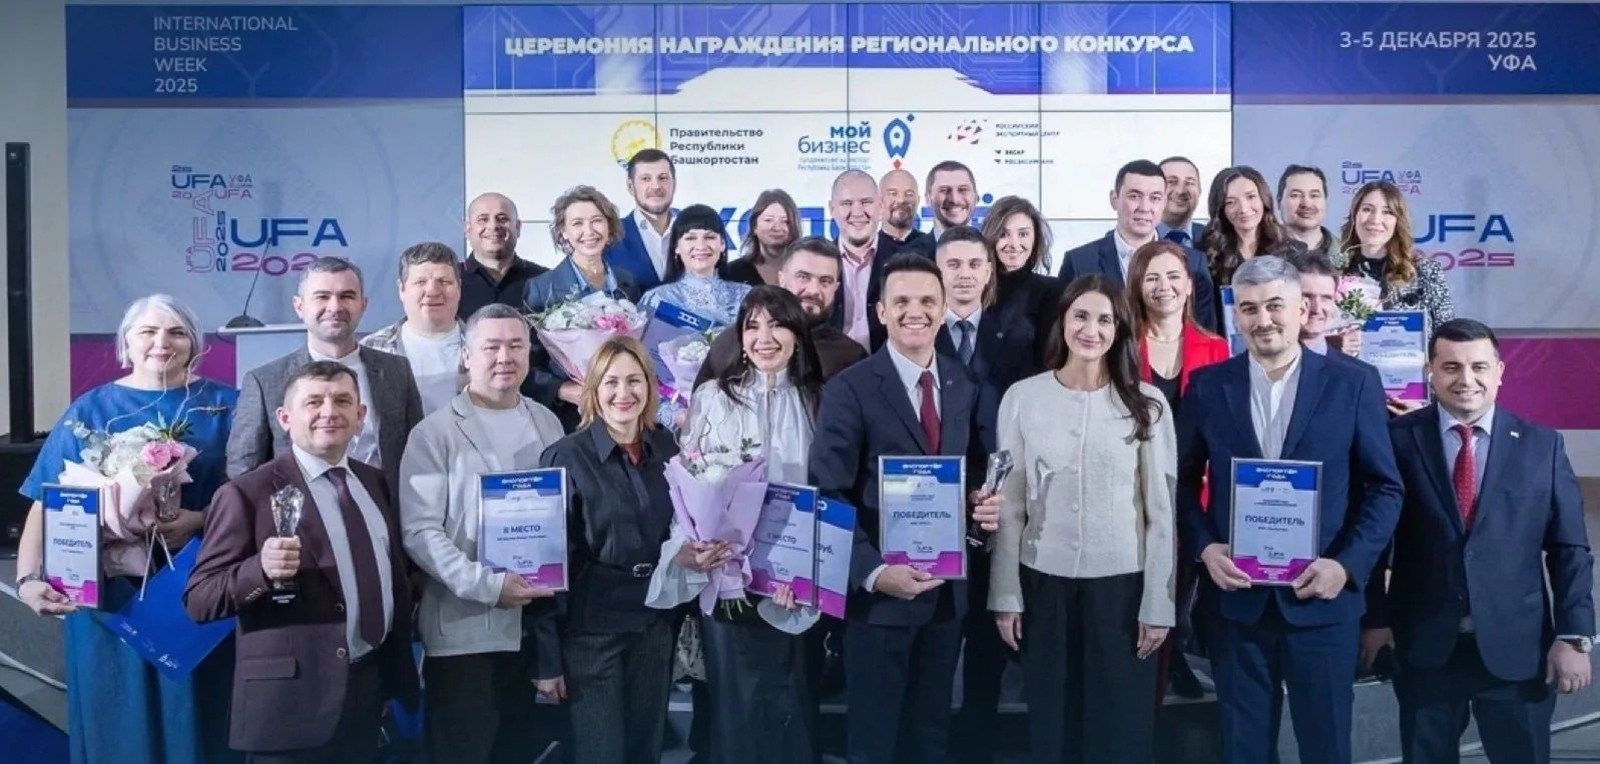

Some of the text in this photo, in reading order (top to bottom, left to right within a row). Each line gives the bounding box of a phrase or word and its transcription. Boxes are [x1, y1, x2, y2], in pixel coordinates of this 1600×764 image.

[153, 15, 299, 31] INTERNATIONAL
[153, 36, 242, 51] BUSINESS
[505, 35, 1194, 57] ЦЕРЕМОНИЯ НАГРАЖДЕНИЯ РЕГИОНАЛЬНОГО КОНКУРСА
[1339, 31, 1537, 51] 3-5 ДЕКАБРЯ 2025
[153, 57, 208, 72] WEEK
[1487, 53, 1537, 71] УФА
[154, 78, 199, 93] 2025
[669, 128, 764, 139] Правительство
[830, 121, 871, 138] мой
[669, 141, 745, 153] Республики
[798, 135, 871, 154] бизнес
[670, 155, 759, 166] Башкортостан
[171, 174, 227, 189] UFA
[1342, 170, 1396, 185] UFA
[214, 188, 252, 199] UFA
[230, 218, 348, 247] UFA
[216, 210, 229, 272] 2025
[231, 253, 349, 276] 202
[893, 511, 952, 519] ПОБЕДИТЕЛЬ
[1245, 515, 1305, 526] ПОБЕДИТЕЛЬ
[511, 525, 541, 533] МЕСТО
[53, 538, 93, 549] ПОБЕДИТЕЛЬ
